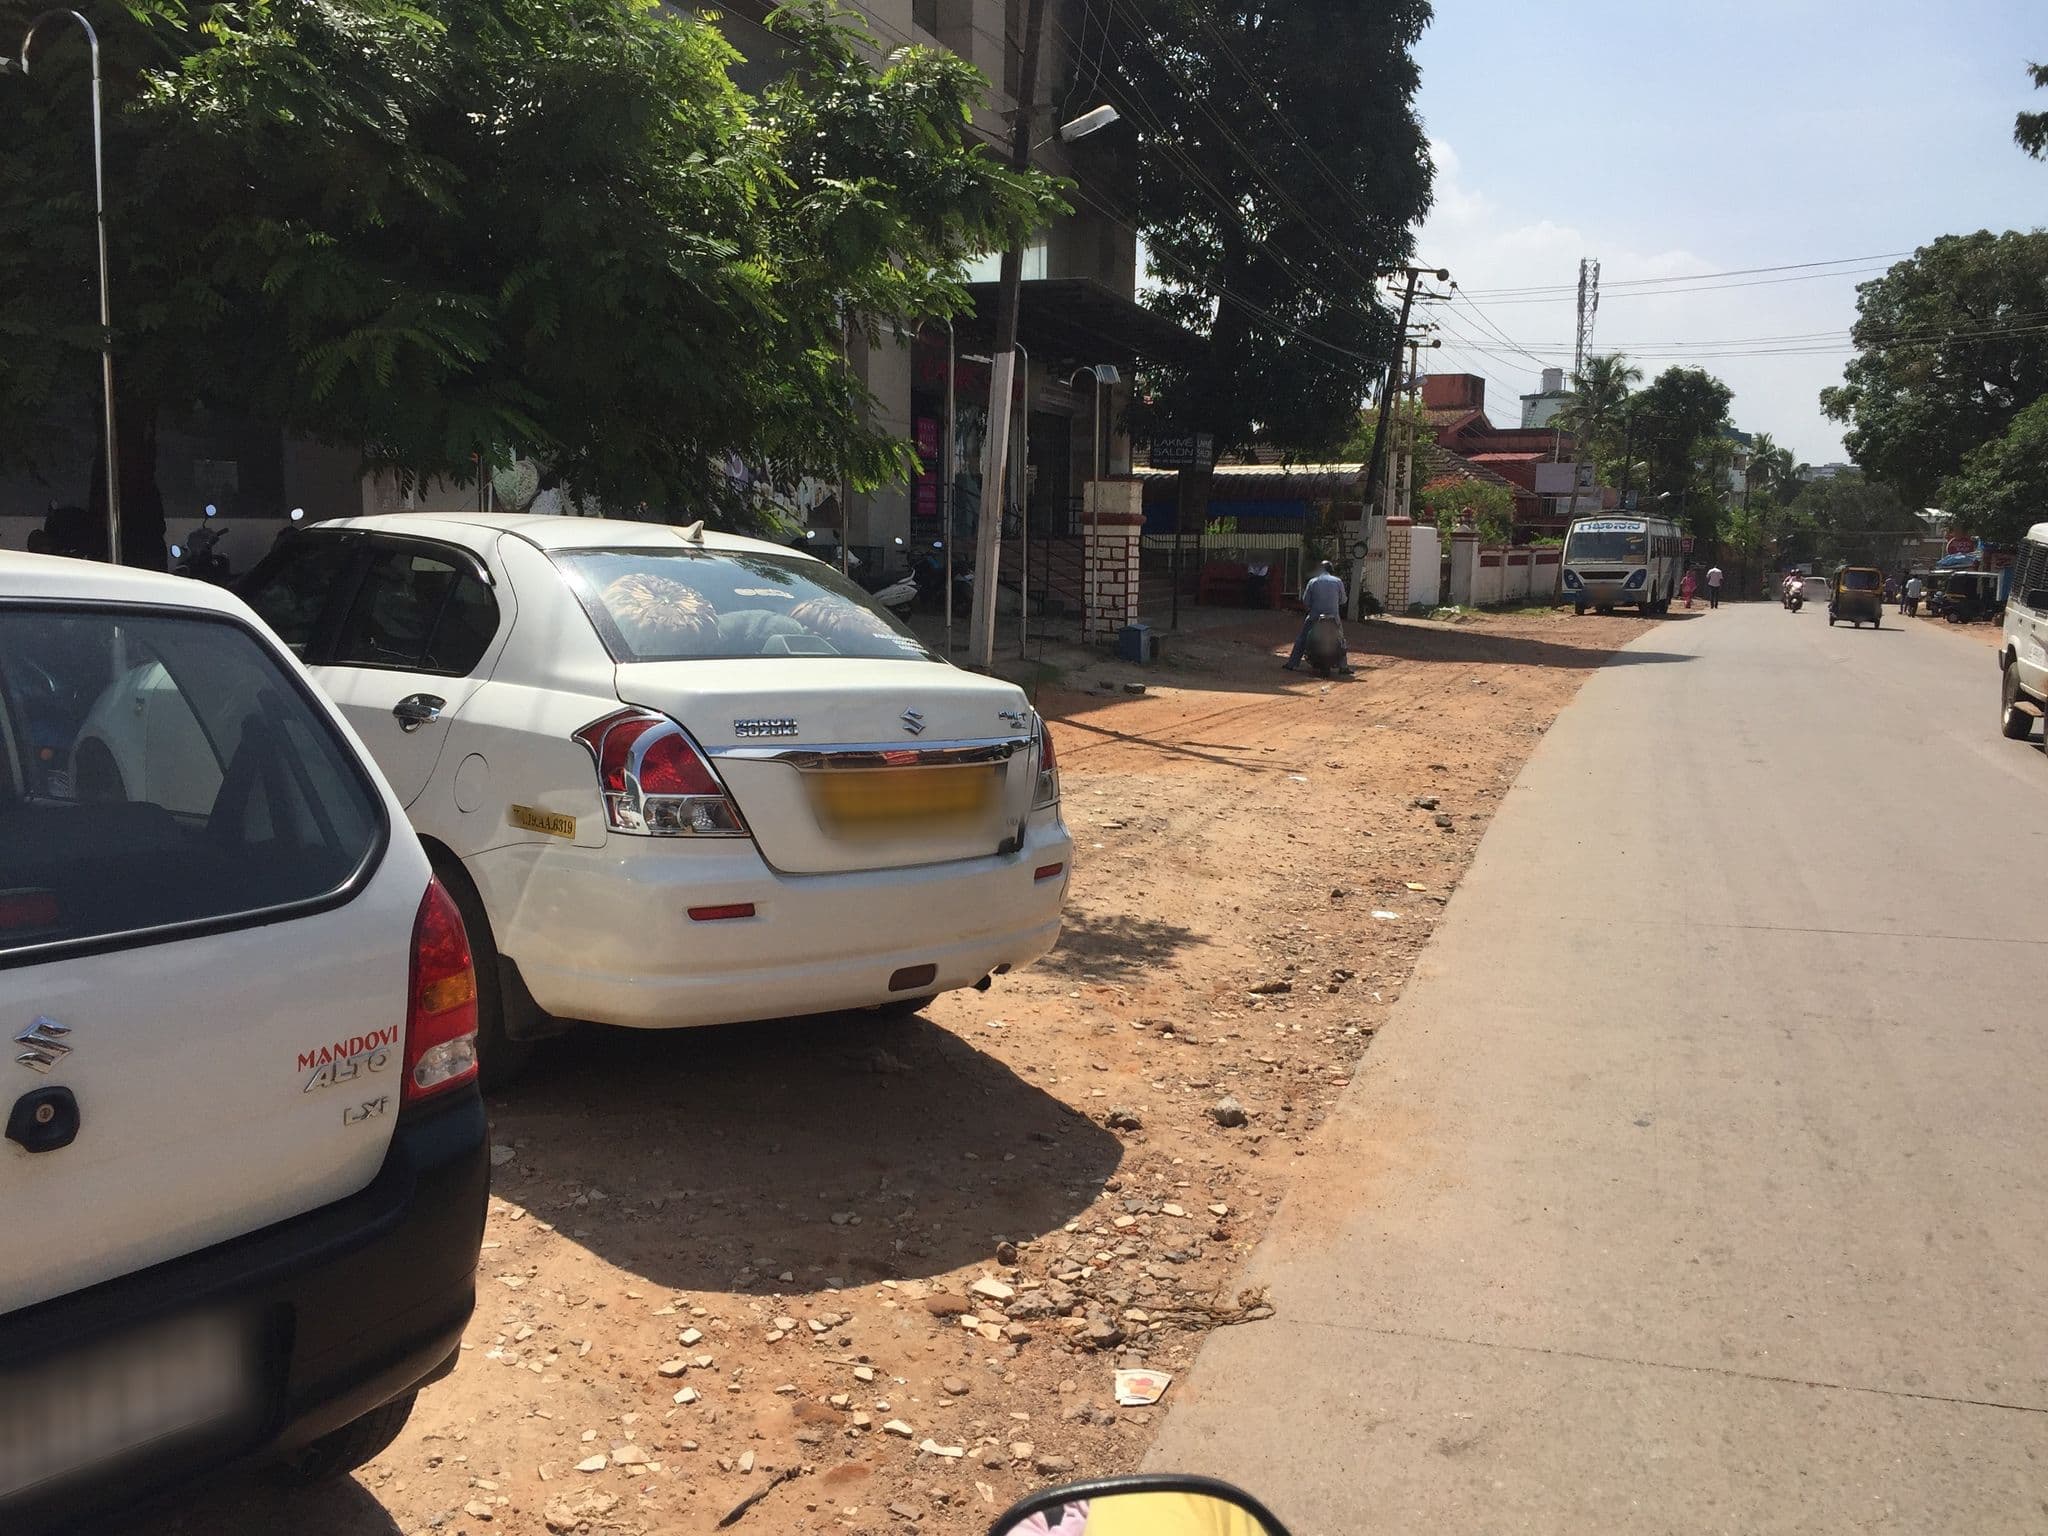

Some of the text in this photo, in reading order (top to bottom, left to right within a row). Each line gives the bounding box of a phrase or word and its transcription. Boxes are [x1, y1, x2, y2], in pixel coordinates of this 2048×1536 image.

[1153, 447, 1194, 457] SALON
[733, 719, 798, 728] MARUTI
[735, 727, 799, 738] SUZUKI
[297, 1023, 398, 1072] MANDOVI
[303, 1047, 391, 1094] ALTO
